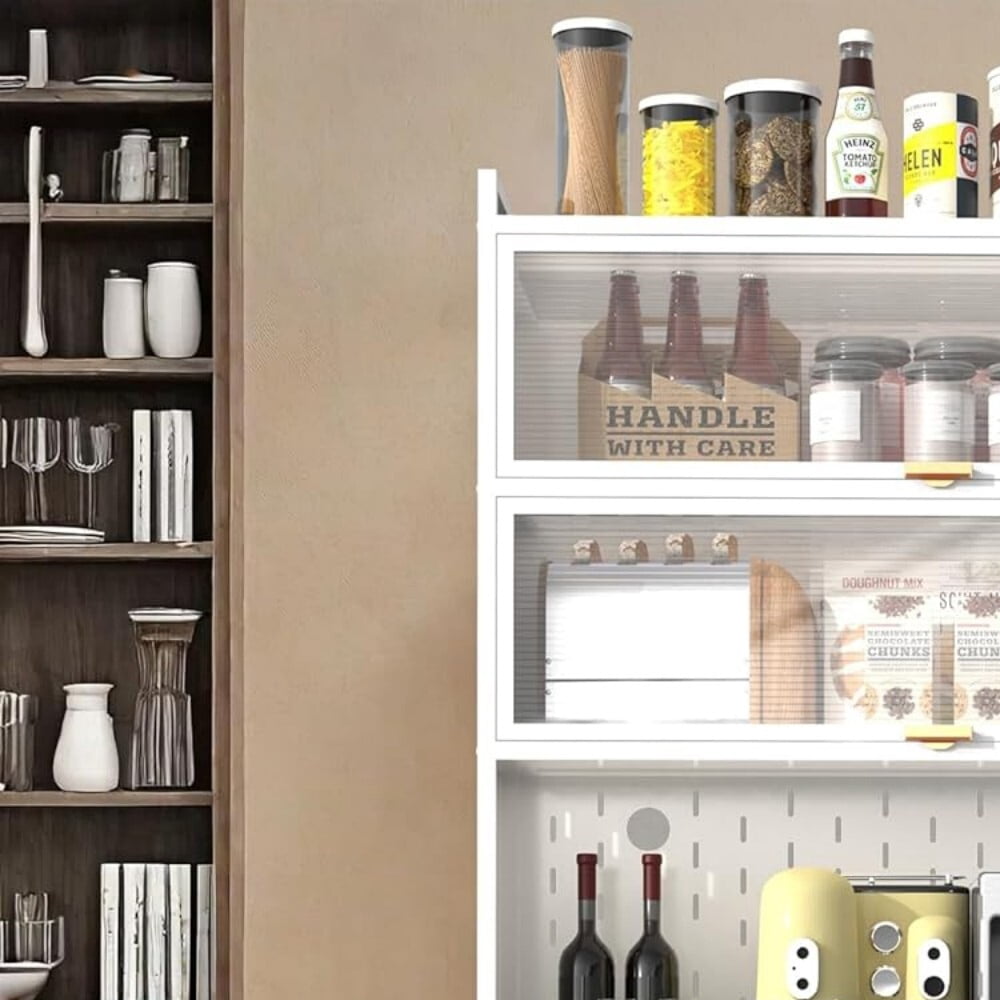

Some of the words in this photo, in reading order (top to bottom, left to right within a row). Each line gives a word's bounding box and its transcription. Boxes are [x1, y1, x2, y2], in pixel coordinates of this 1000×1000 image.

[844, 137, 876, 149] HEINZ
[843, 152, 877, 162] TOMATO
[606, 405, 776, 429] HANDLE
[607, 440, 686, 456] WITH
[697, 440, 776, 457] CARE
[843, 577, 900, 589] DOUGHNUT
[903, 577, 924, 588] MIX
[867, 630, 931, 638] SEMISWEET
[867, 638, 931, 646] CHOCOLATE
[867, 646, 932, 658] CHUNKS
